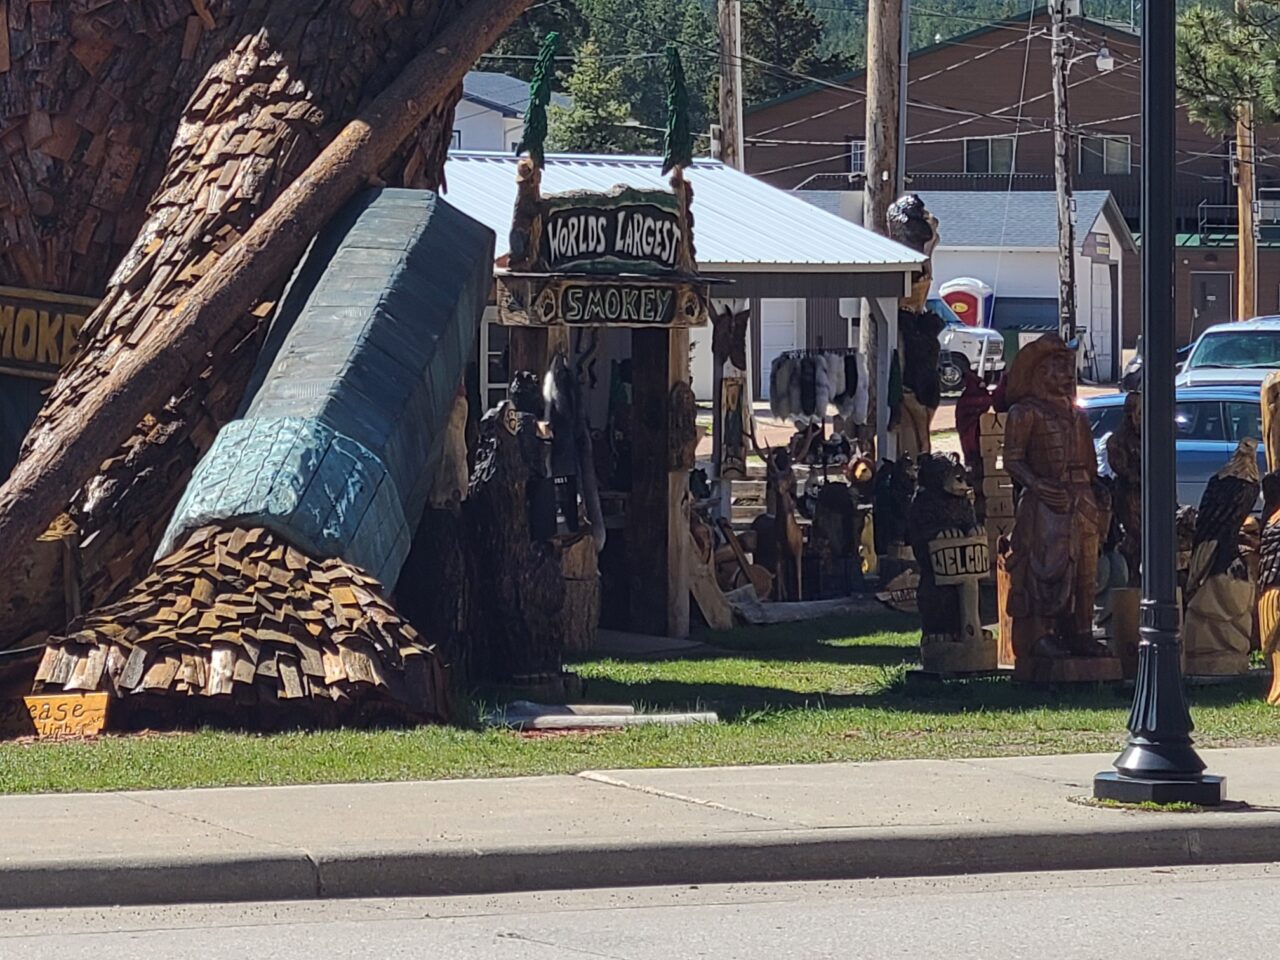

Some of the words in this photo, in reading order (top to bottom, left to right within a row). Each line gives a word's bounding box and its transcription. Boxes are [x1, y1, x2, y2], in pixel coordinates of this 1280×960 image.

[547, 215, 607, 263] WORLDS
[614, 211, 681, 264] LARGEST
[566, 288, 672, 322] SMOKEY
